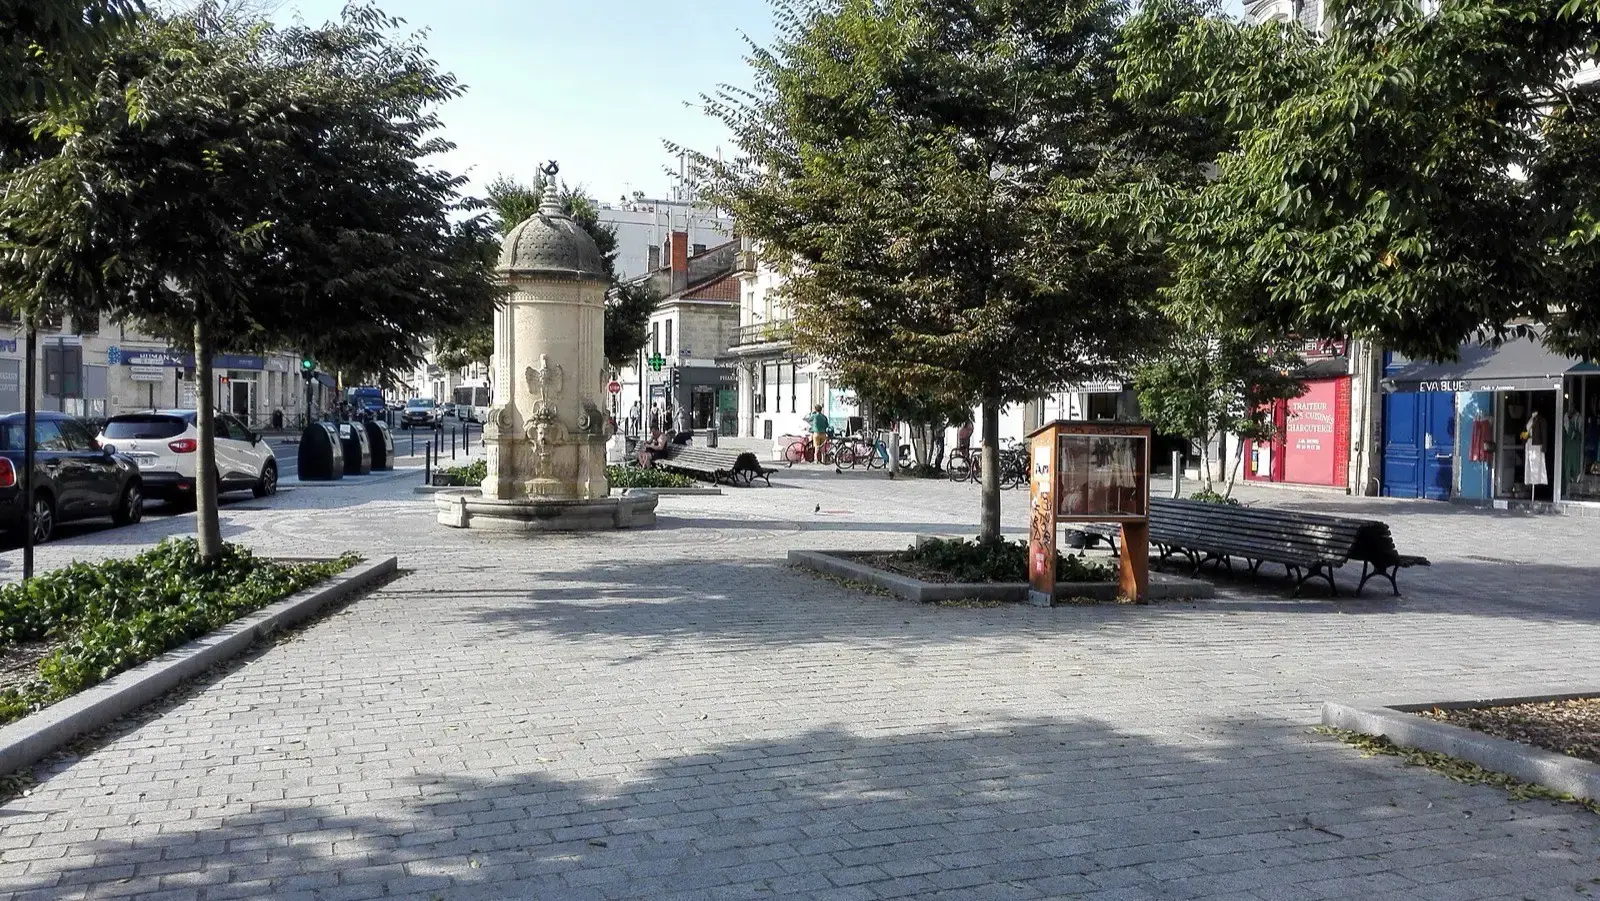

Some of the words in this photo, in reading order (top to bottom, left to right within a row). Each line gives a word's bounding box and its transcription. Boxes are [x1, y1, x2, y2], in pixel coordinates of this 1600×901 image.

[1419, 382, 1438, 392] EVA
[1440, 380, 1465, 391] BLUE
[1293, 402, 1327, 411] TRAITEUR
[1286, 423, 1333, 433] CHARCUTERIE
